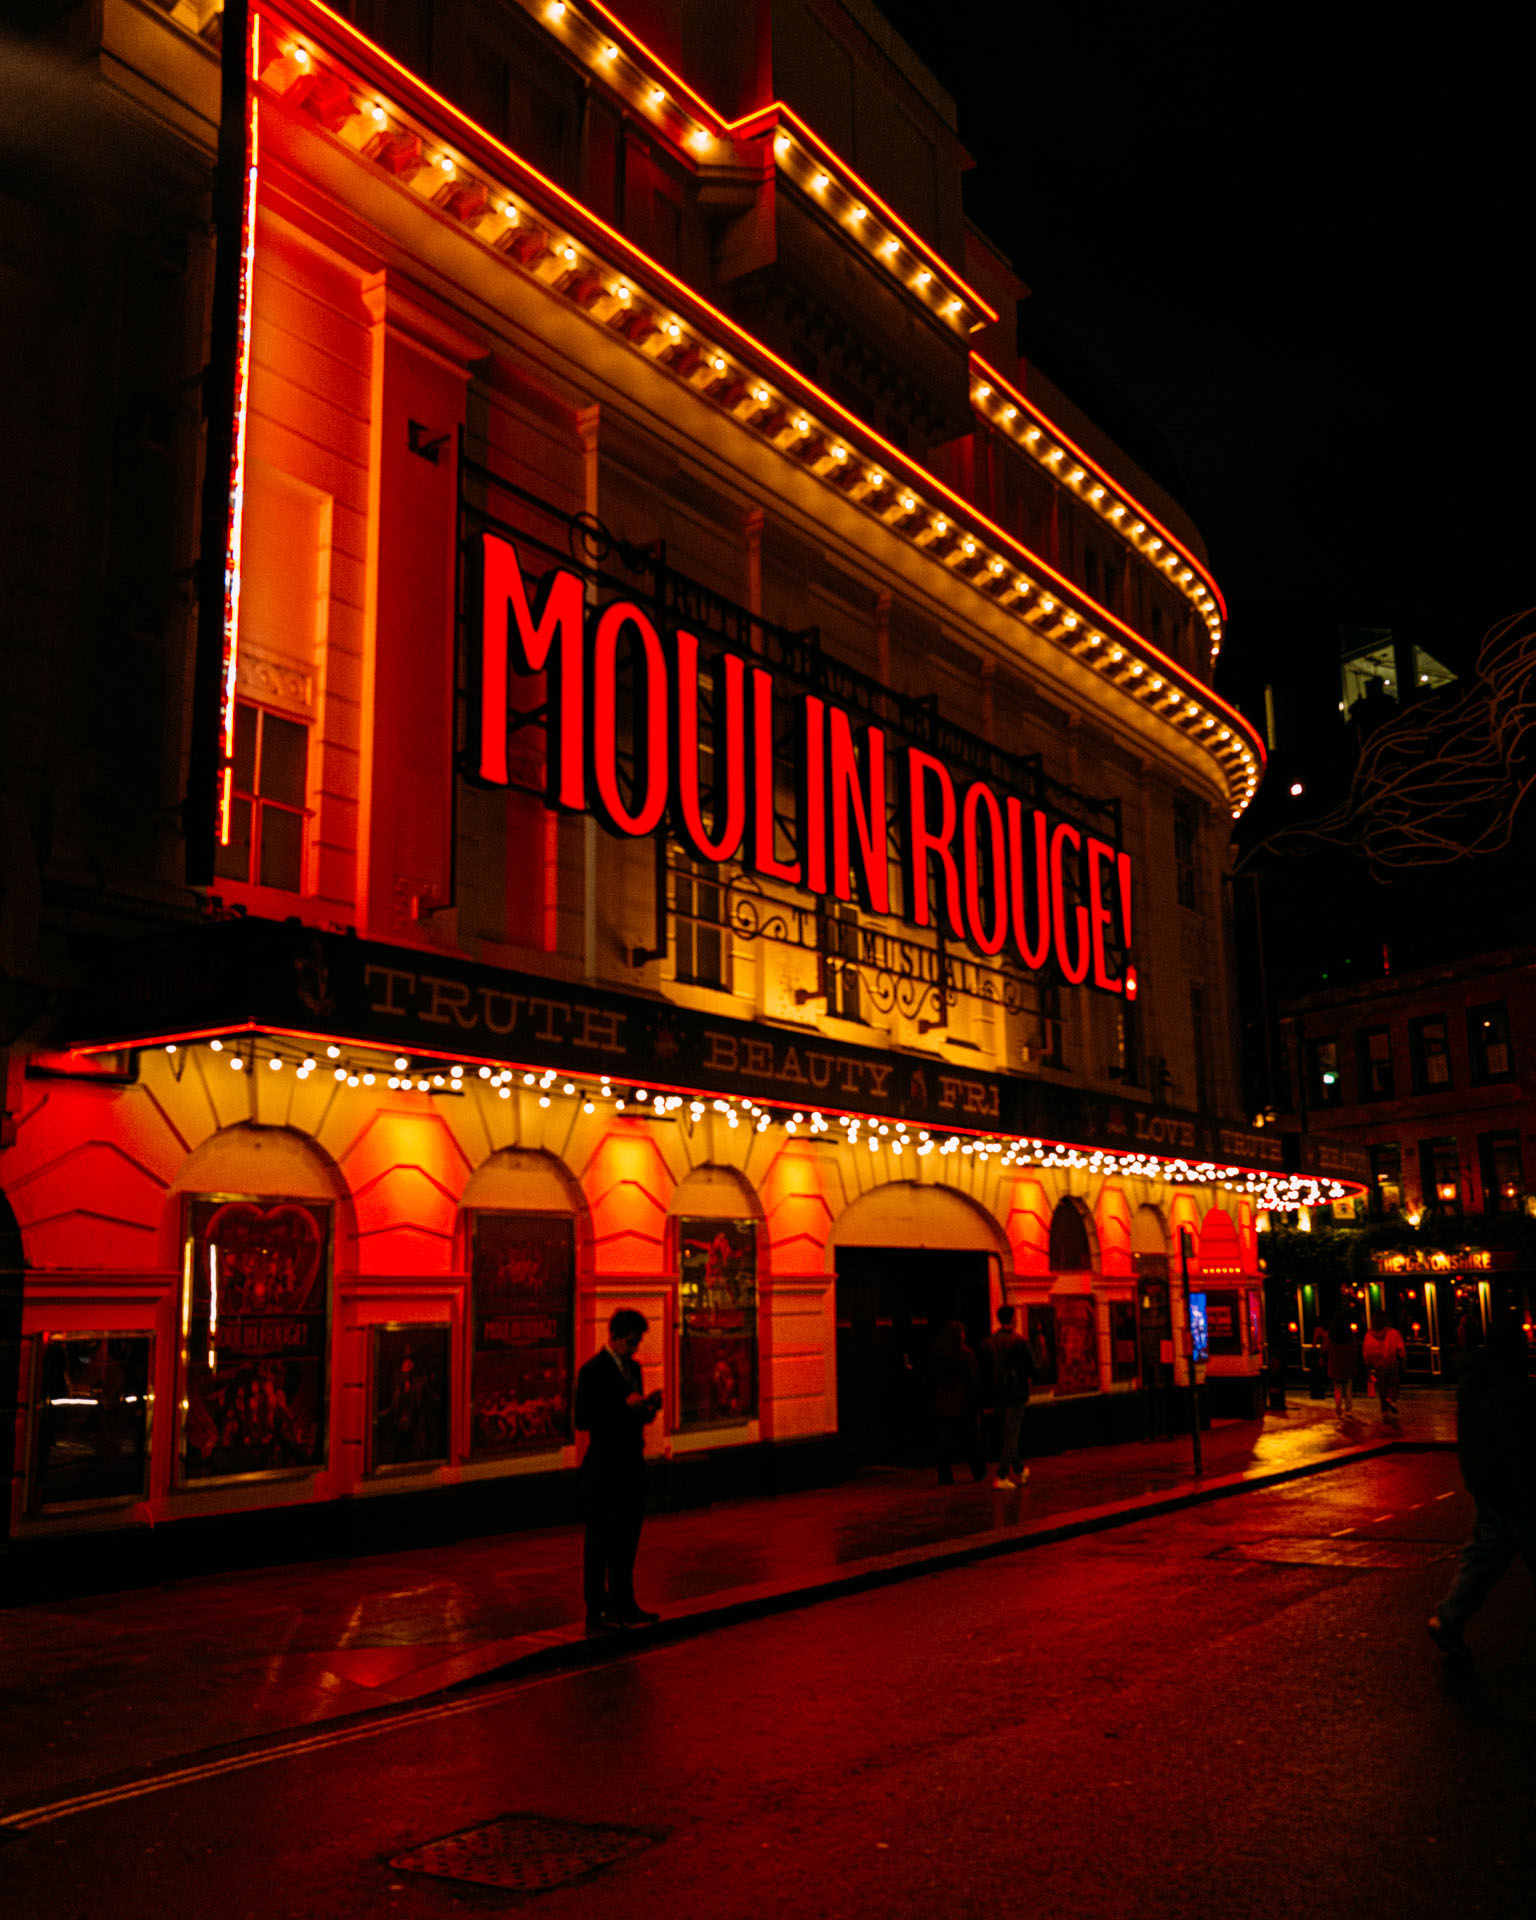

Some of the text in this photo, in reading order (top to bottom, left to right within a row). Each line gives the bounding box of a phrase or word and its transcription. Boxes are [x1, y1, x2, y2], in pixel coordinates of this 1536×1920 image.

[480, 531, 1134, 1001] MOULIN ROUGE!
[364, 963, 629, 1054] TRUTH
[702, 1030, 893, 1099] BEAUTY
[1134, 1112, 1196, 1148] LOVE
